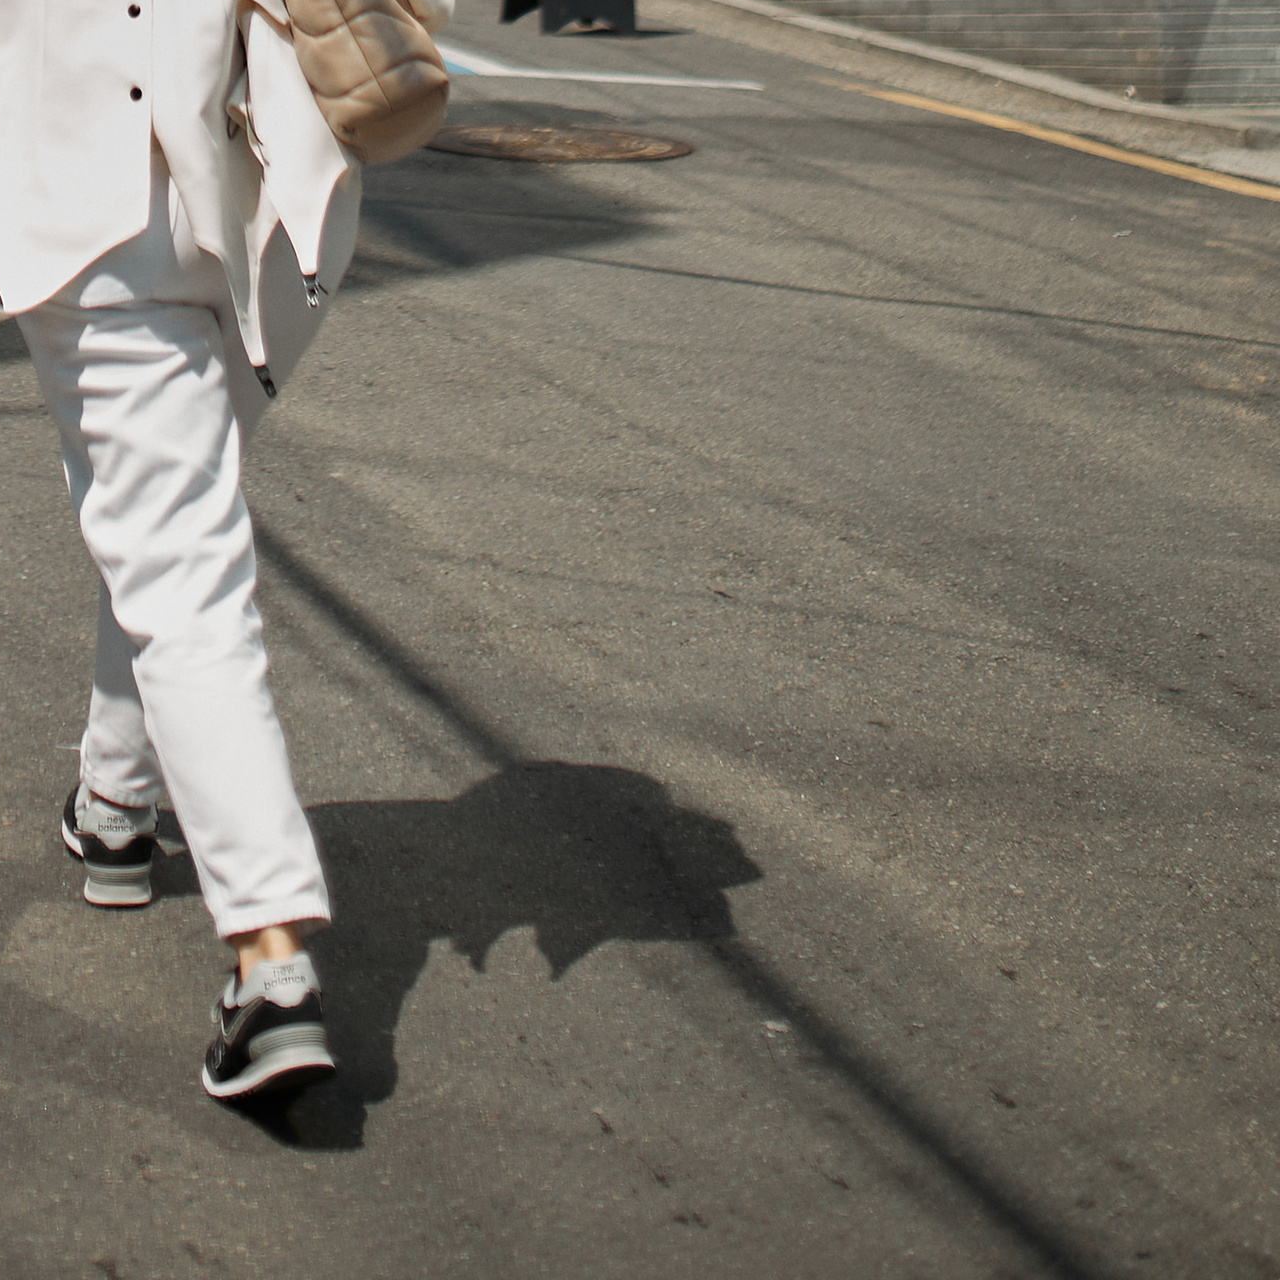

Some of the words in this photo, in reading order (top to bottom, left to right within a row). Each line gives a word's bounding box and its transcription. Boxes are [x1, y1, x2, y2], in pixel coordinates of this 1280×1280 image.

[107, 814, 125, 824] new
[98, 822, 135, 832] balance
[272, 964, 295, 978] new
[263, 975, 306, 990] balance
